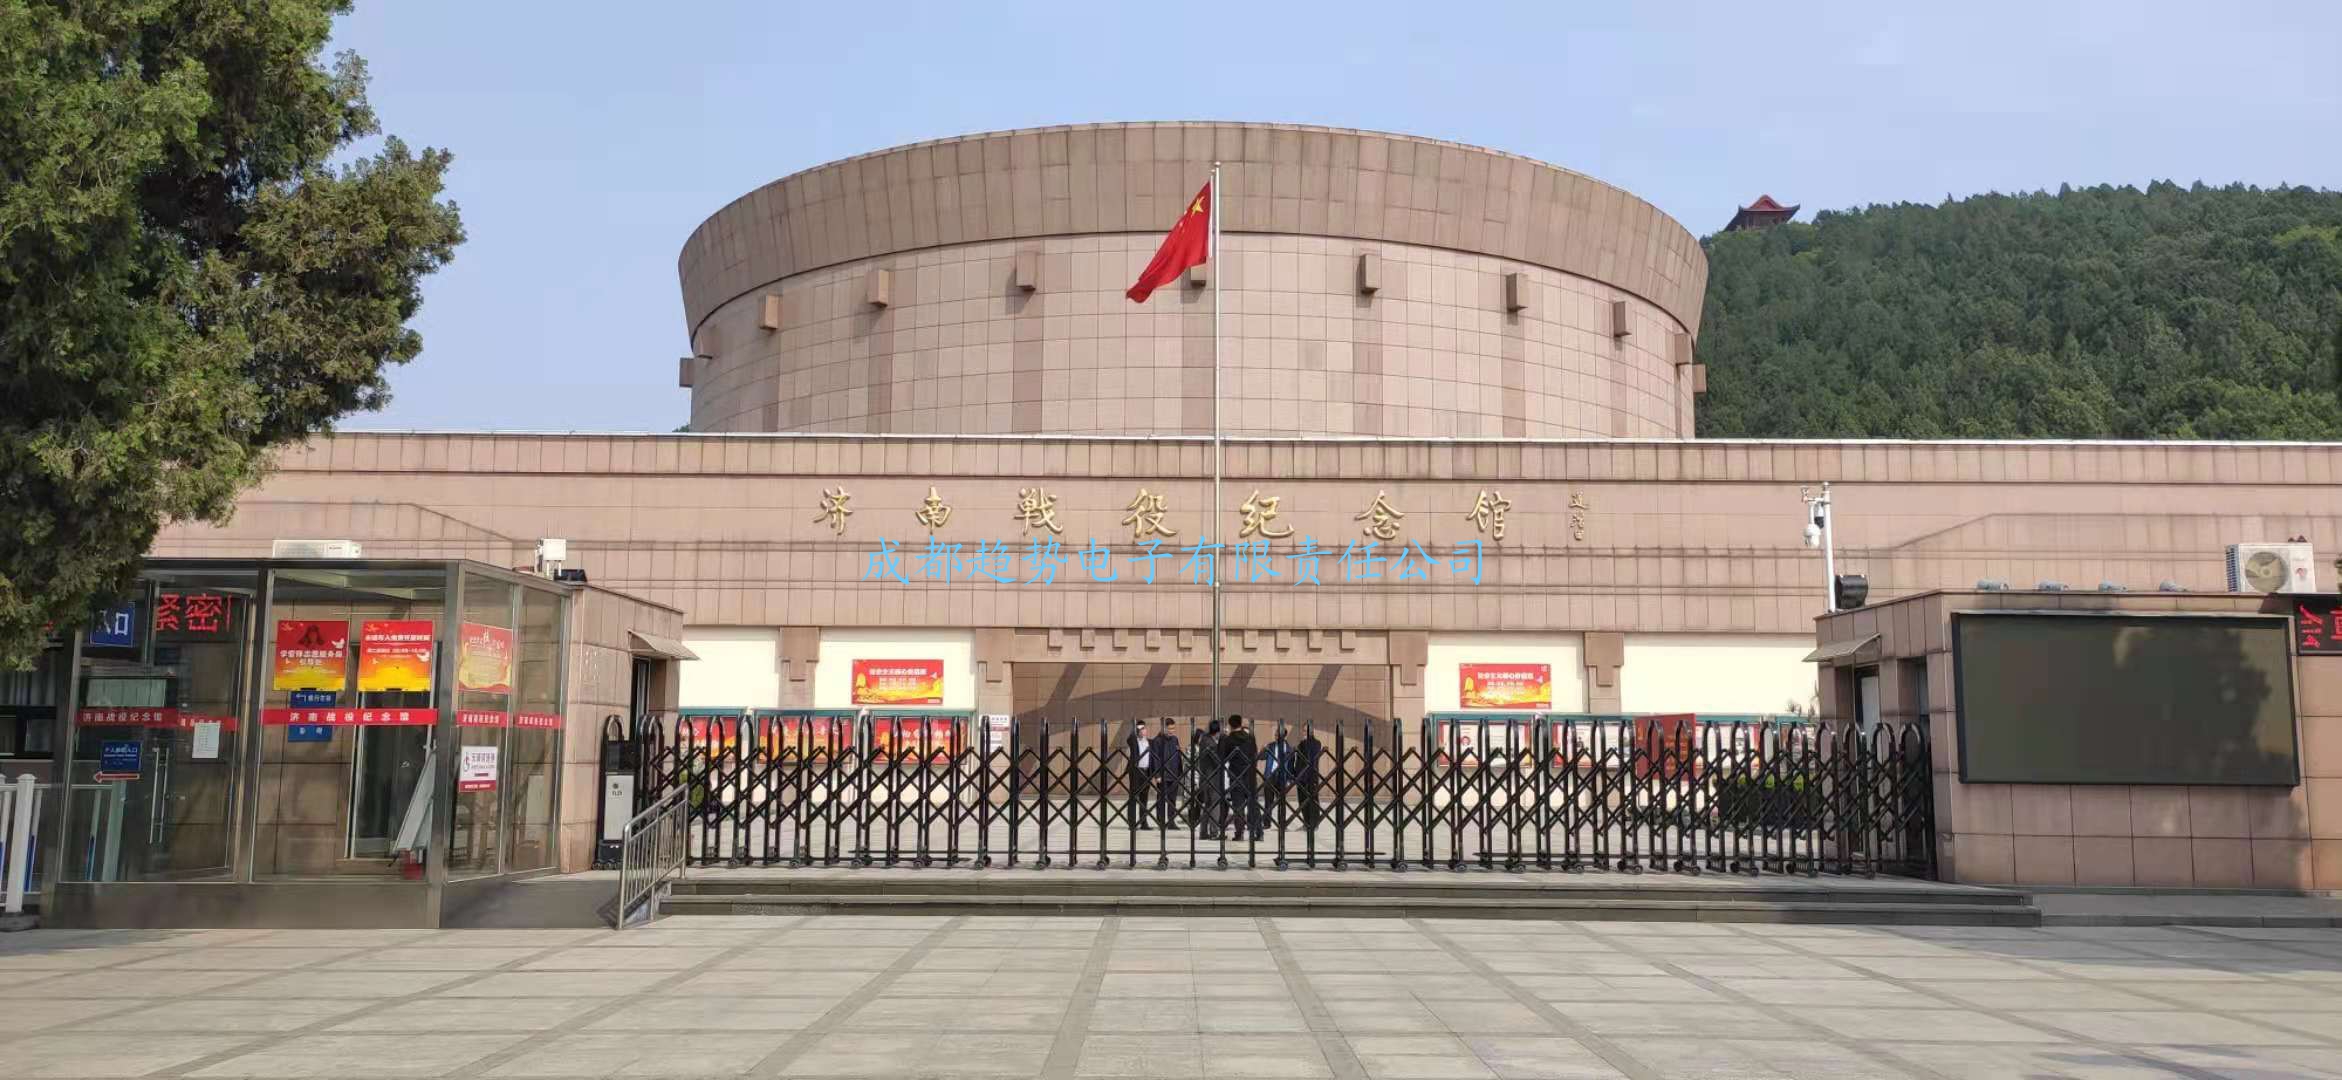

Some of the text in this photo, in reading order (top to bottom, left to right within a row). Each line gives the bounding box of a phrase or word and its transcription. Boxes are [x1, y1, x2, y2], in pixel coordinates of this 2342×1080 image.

[289, 711, 410, 722] 济南战役纪念馆
